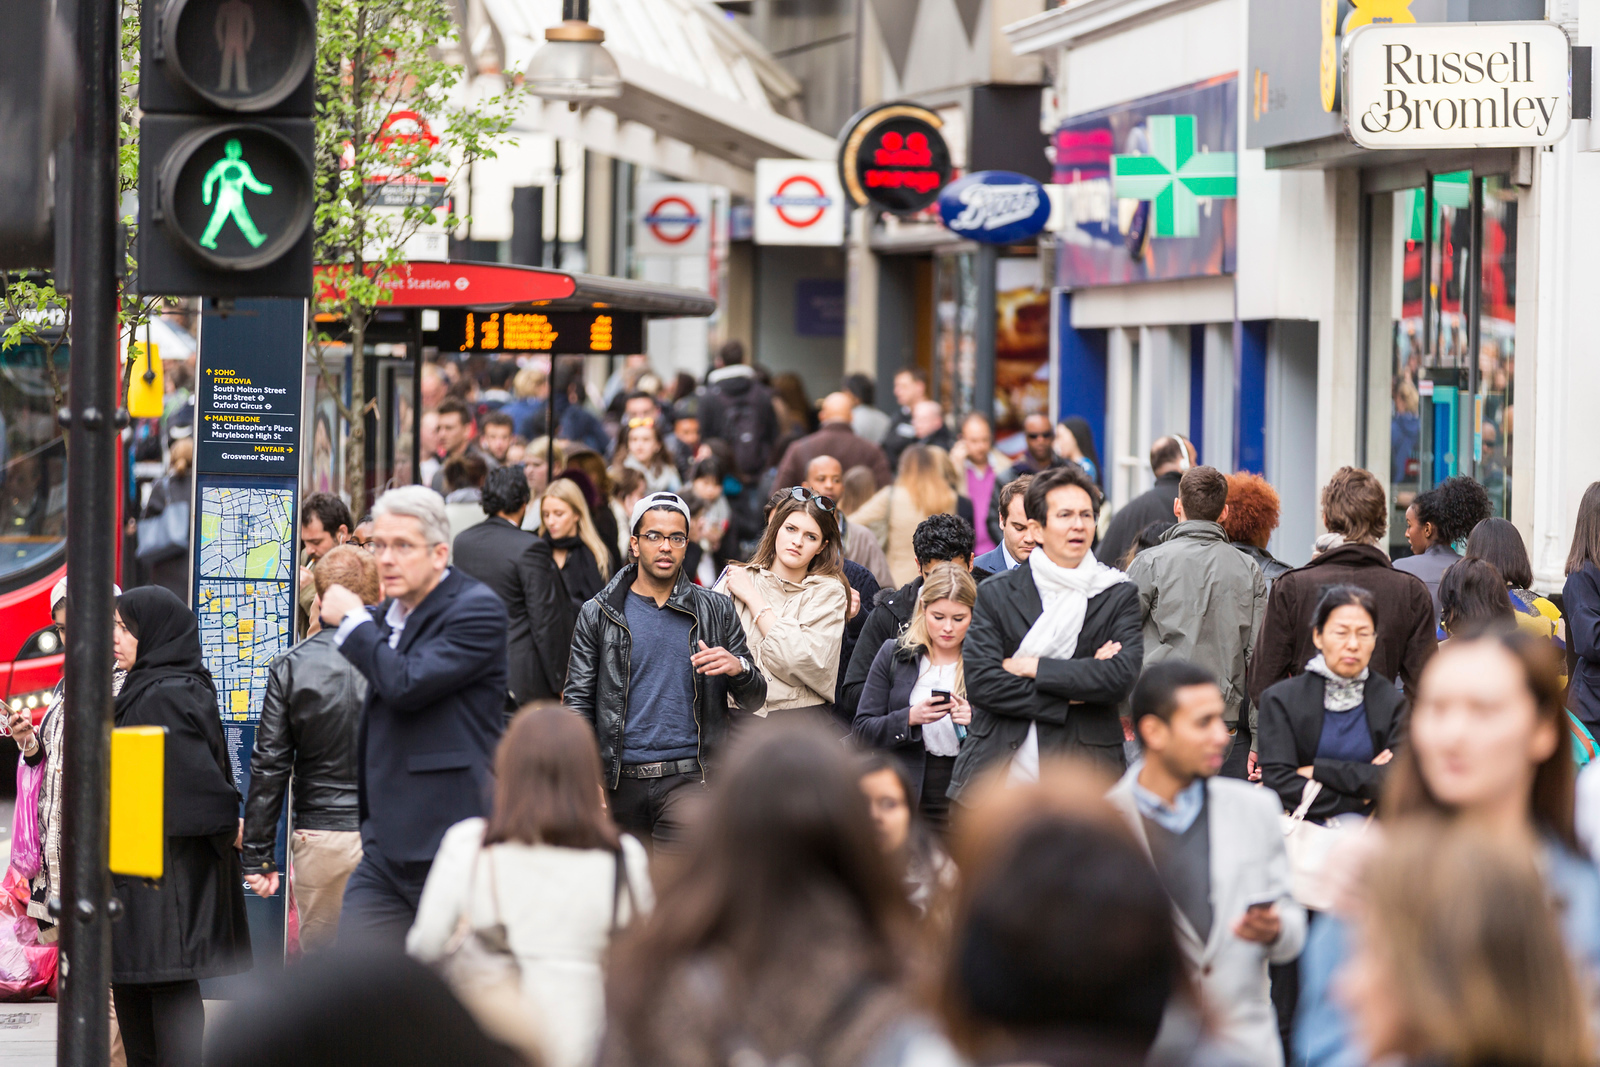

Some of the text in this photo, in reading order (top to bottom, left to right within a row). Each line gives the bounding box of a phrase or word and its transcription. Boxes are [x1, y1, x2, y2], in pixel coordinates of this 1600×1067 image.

[1382, 41, 1534, 85] Russell
[407, 278, 451, 290] Station
[213, 385, 235, 393] South
[213, 393, 232, 401] Bond
[213, 401, 263, 410] Oxford Circus
[223, 423, 272, 432] Christopher's
[273, 424, 293, 432] Place
[211, 431, 282, 441] Marylebone High St
[221, 453, 285, 462] Grosvenor Square
